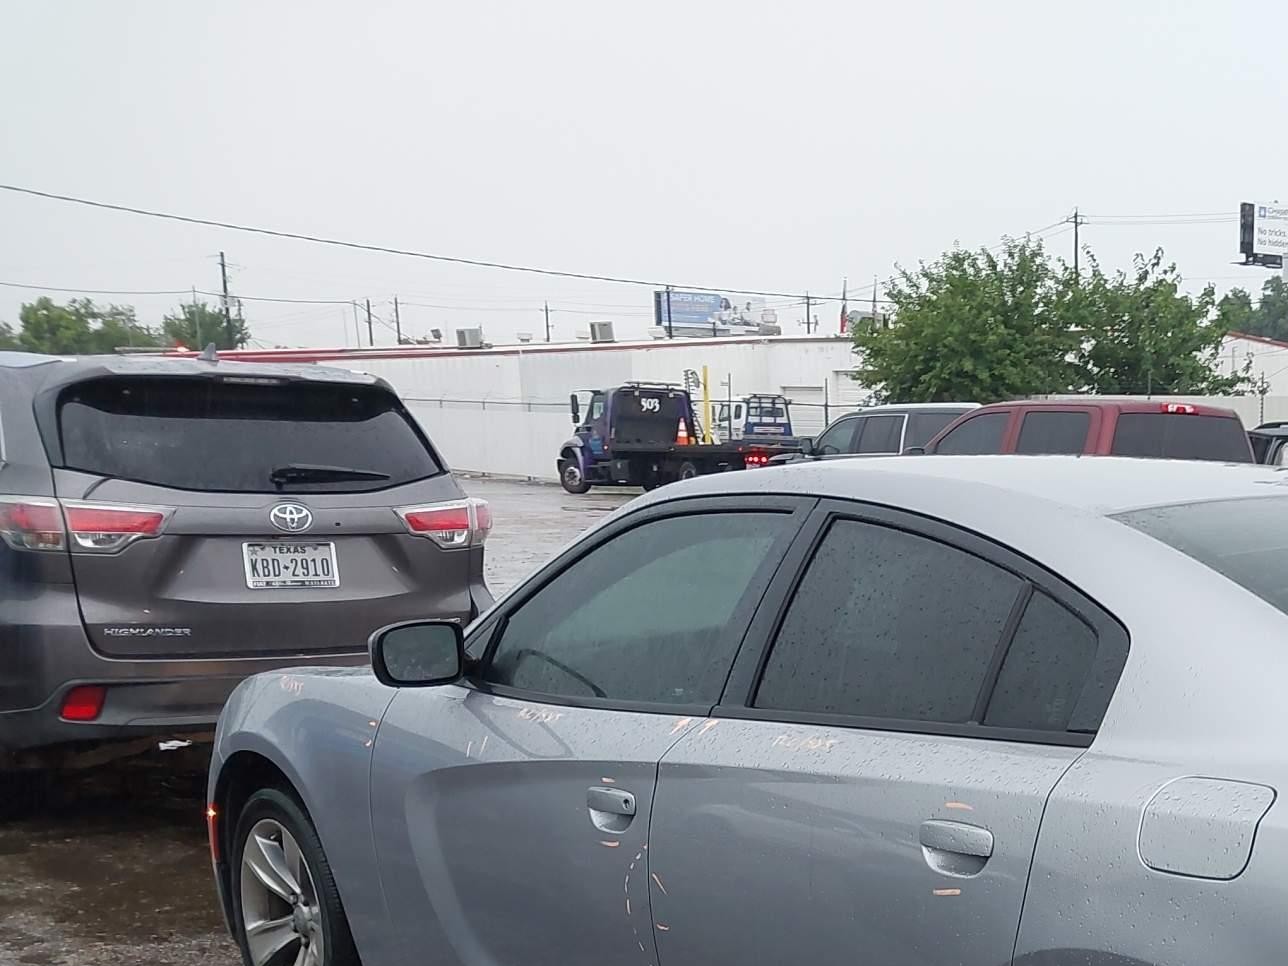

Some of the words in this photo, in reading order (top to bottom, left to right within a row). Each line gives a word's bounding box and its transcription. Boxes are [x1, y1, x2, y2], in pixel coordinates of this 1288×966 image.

[640, 398, 660, 412] 503
[272, 546, 306, 554] TEXAS
[104, 628, 191, 637] HIGHLANDER
